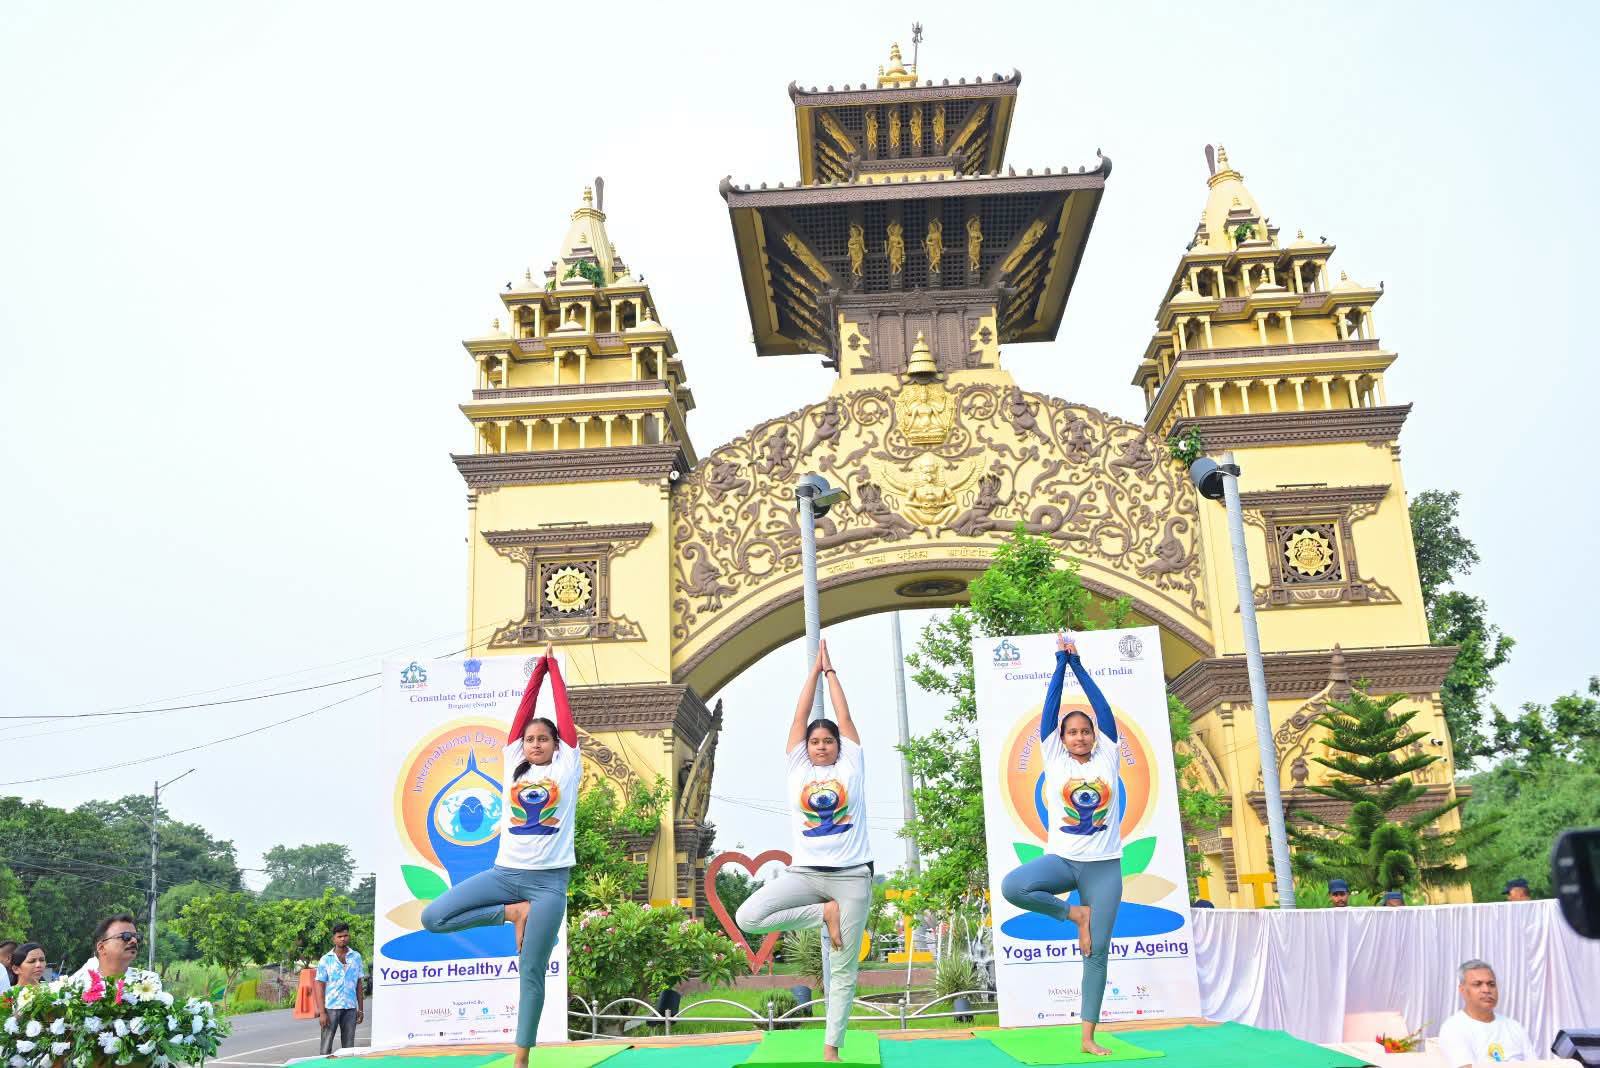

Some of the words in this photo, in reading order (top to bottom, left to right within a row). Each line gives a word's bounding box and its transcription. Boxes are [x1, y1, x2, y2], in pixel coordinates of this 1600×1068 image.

[1004, 671, 1052, 681] Consulate
[1095, 667, 1106, 676] of
[1108, 666, 1133, 676] India
[409, 693, 456, 703] Consulate
[458, 690, 495, 700] General
[498, 689, 510, 697] of
[412, 735, 471, 793] International
[1003, 945, 1041, 961] Yoga
[1046, 944, 1067, 958] for
[1134, 939, 1189, 956] Ageing
[380, 967, 418, 983] Yoga
[422, 965, 443, 978] for
[447, 961, 503, 978] Healthy
